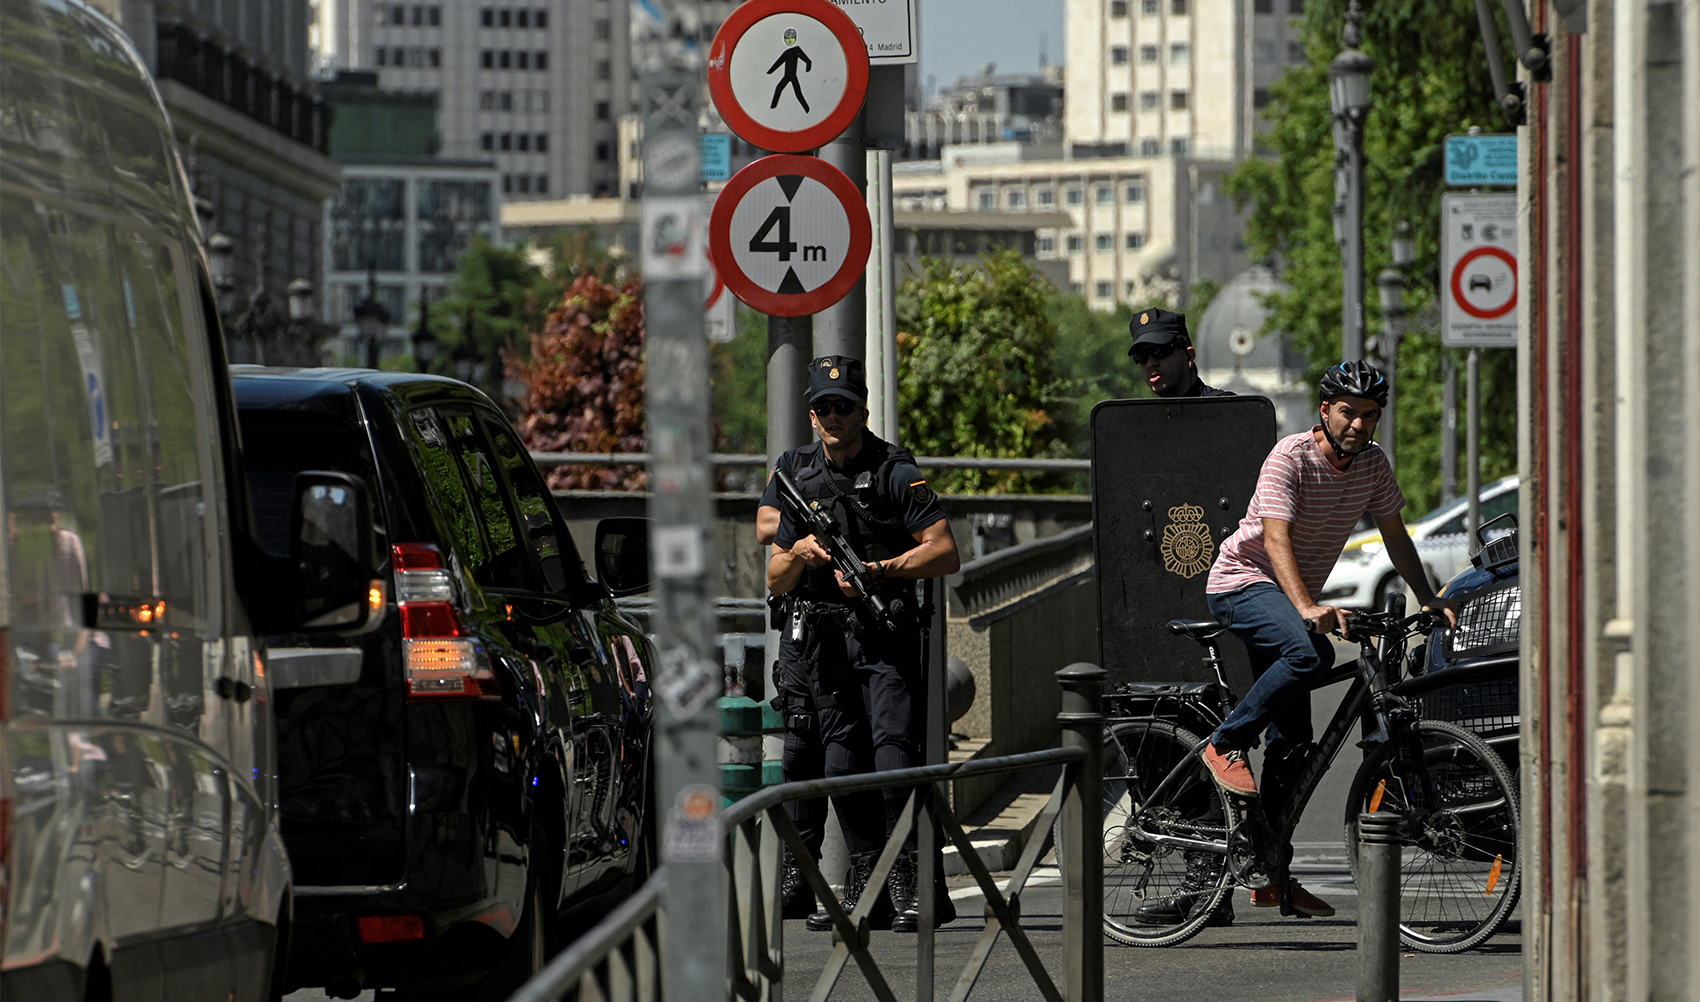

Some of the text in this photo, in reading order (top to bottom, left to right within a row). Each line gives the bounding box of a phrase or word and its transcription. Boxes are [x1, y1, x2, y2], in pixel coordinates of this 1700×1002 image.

[878, 42, 902, 51] Madrid
[749, 206, 826, 262] 4 m
